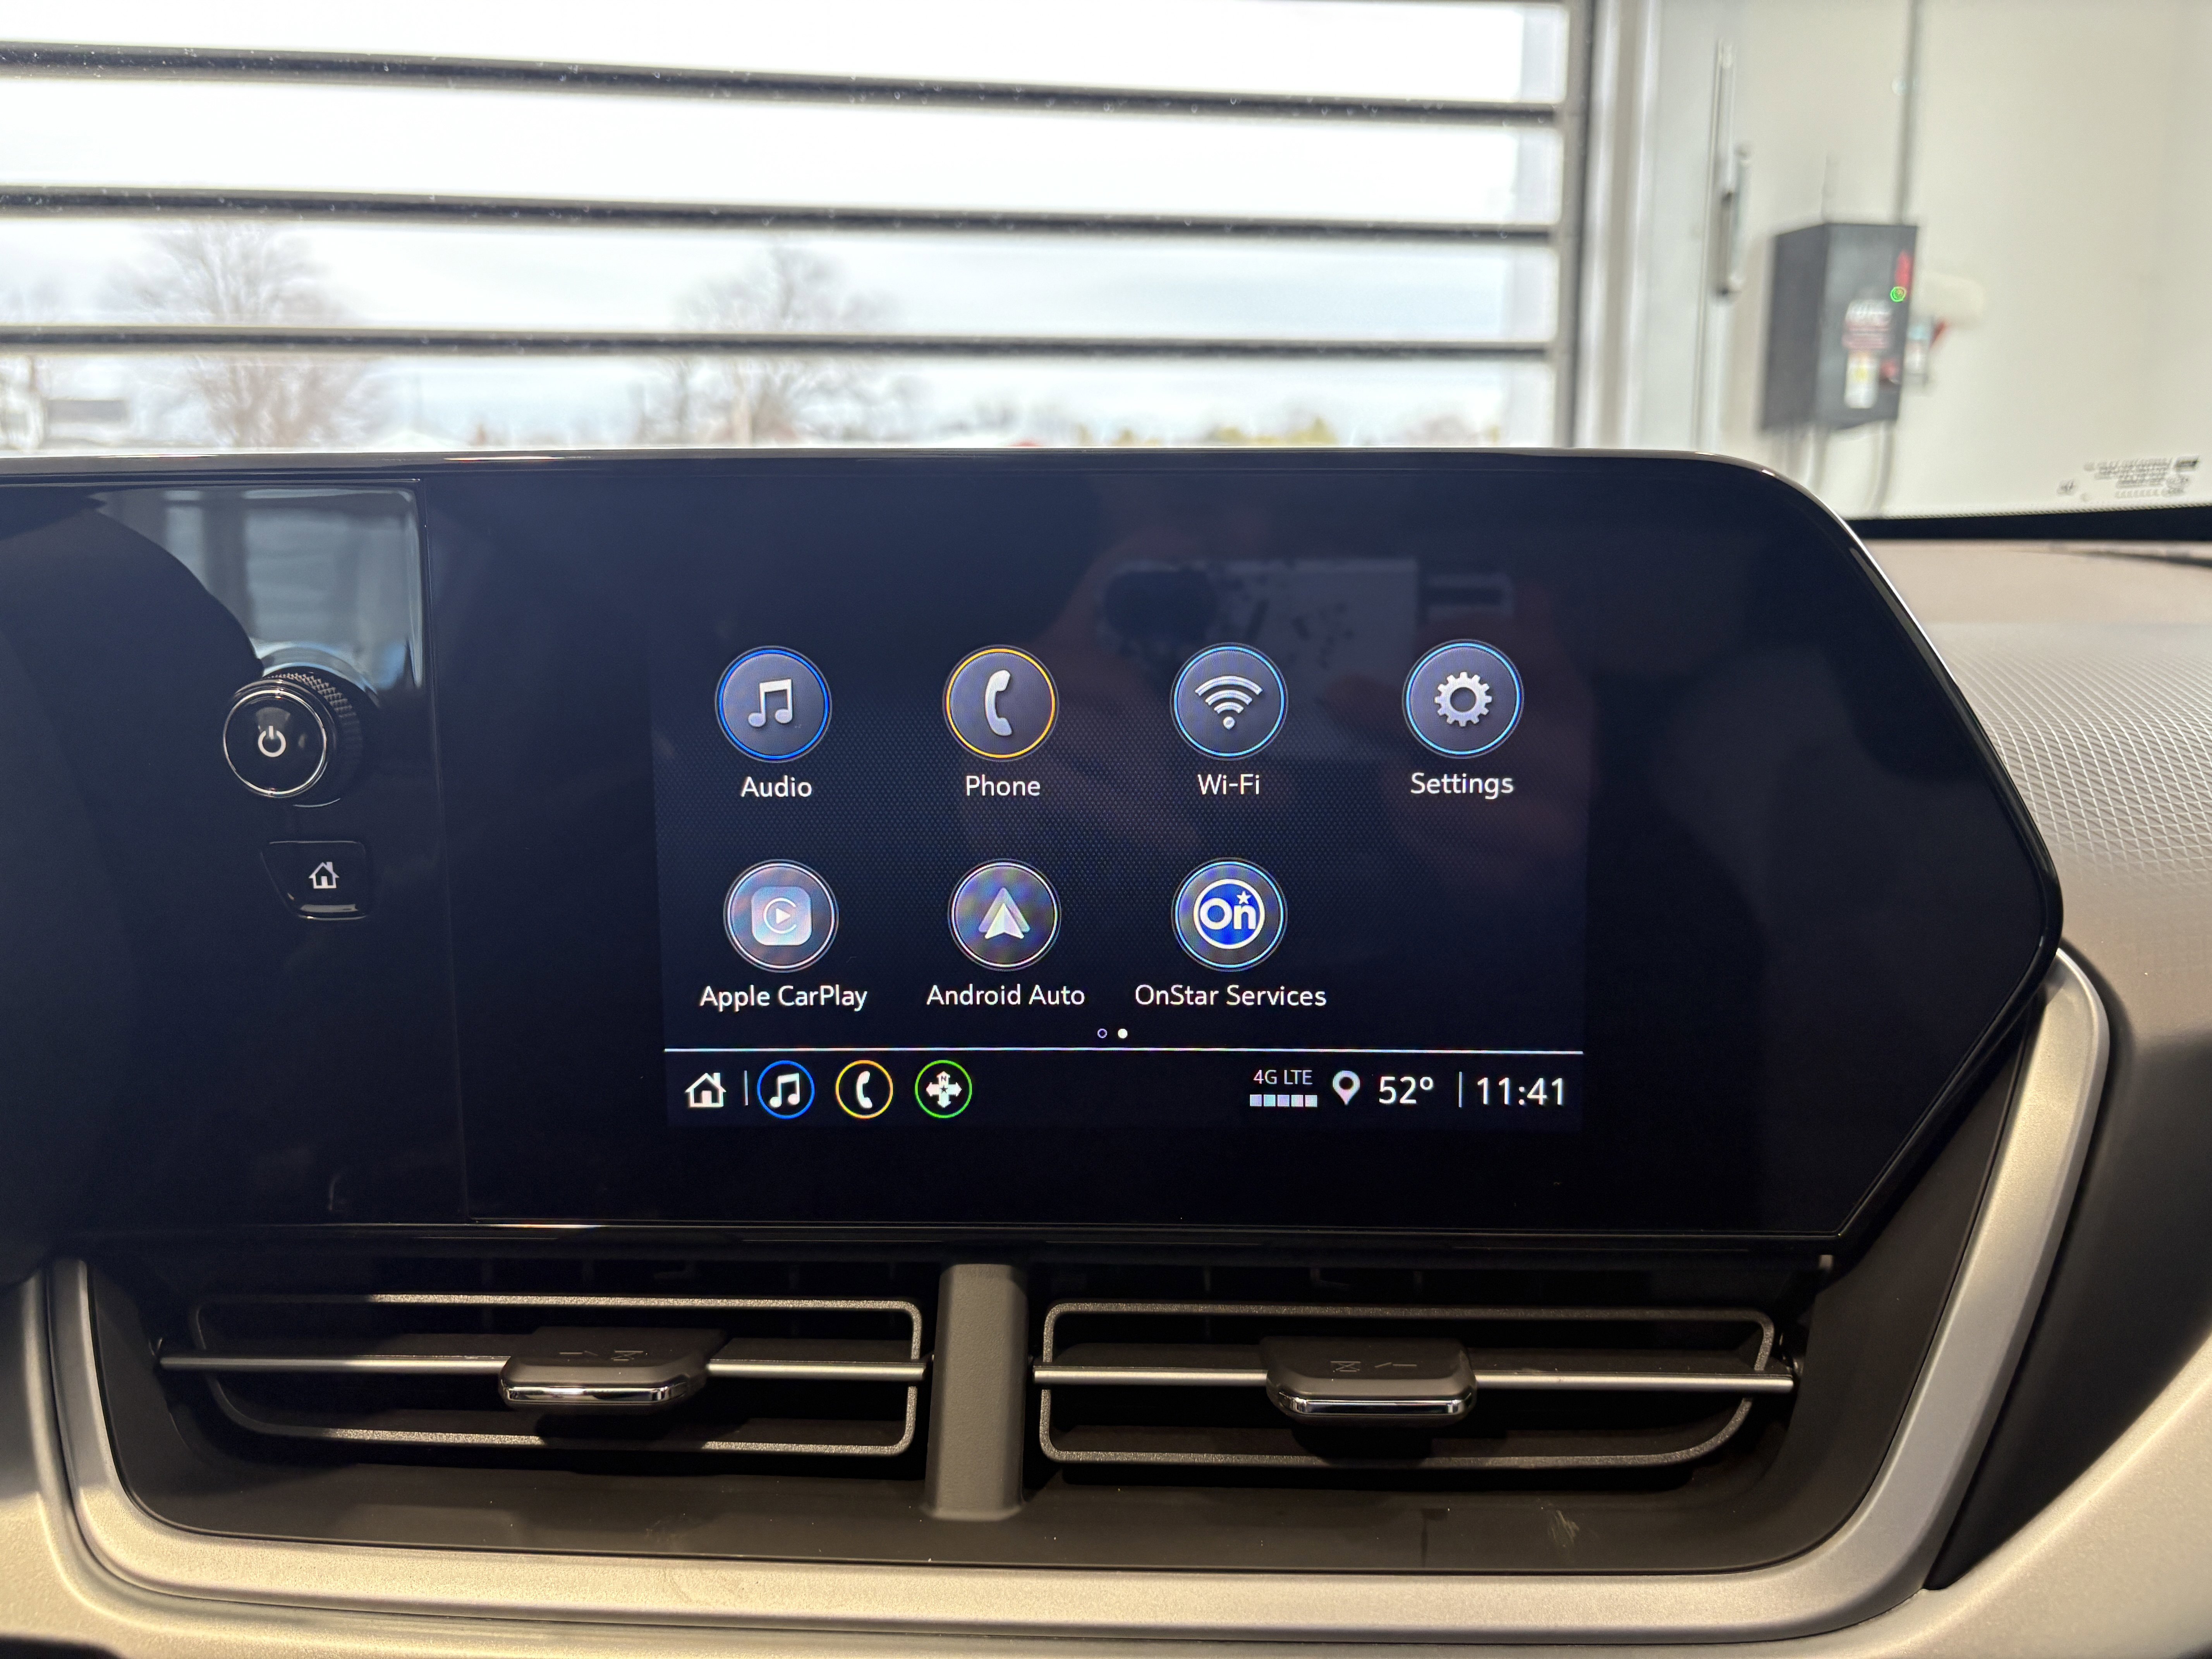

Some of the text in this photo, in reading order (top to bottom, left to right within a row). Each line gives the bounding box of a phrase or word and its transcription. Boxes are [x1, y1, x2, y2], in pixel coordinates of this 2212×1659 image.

[740, 775, 812, 797] Audio
[966, 774, 1041, 796] Phone
[1197, 774, 1260, 795] Wi-Fi
[1410, 772, 1514, 800] Settings
[1200, 897, 1256, 930] On
[700, 984, 867, 1012] Apple CarPlay
[926, 983, 1085, 1005] Android Auto
[1135, 984, 1327, 1006] OnStar Services
[1253, 1070, 1313, 1085] 4G LTE
[1477, 1077, 1563, 1105] 11:41
